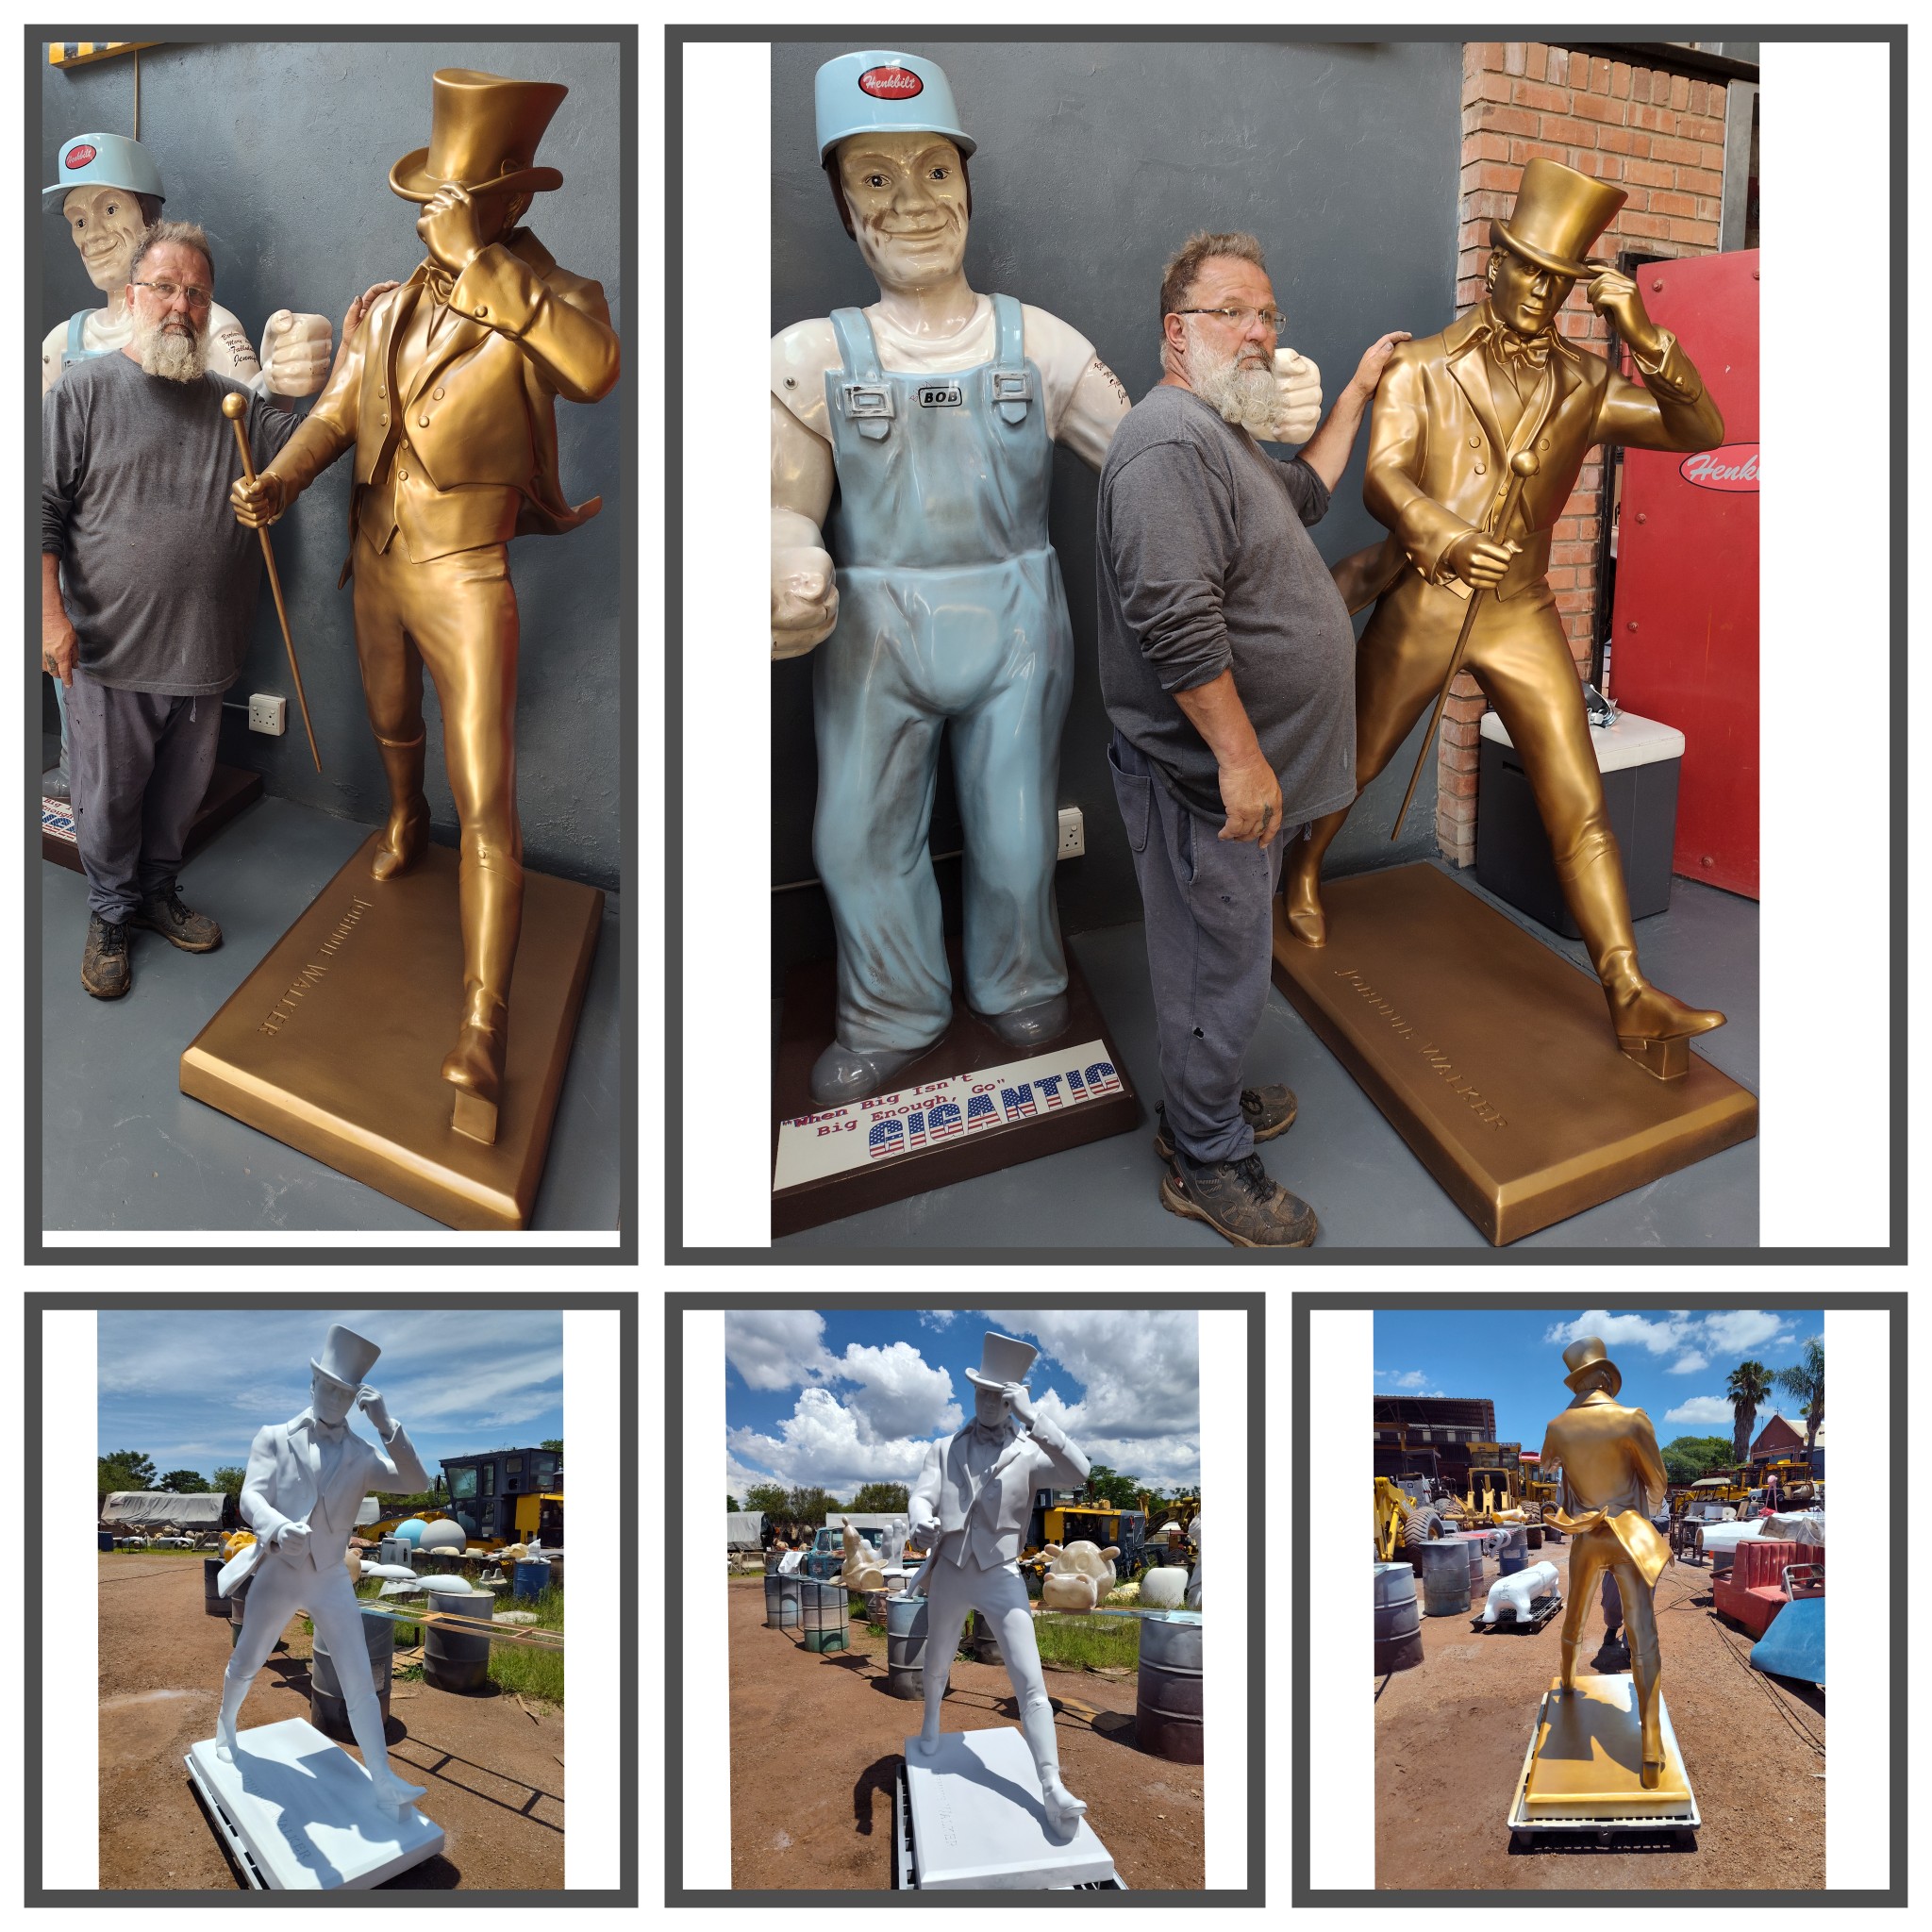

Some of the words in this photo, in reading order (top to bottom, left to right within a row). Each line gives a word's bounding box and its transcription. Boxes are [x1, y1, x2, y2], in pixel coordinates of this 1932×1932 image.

[862, 75, 916, 90] Henkbilt
[924, 391, 958, 404] BOB
[316, 895, 375, 958] JOHNNIE
[257, 963, 328, 1036] WALKER
[1334, 968, 1420, 1040] JOHNNIE
[1419, 1041, 1508, 1131] WALKER
[817, 1120, 858, 1137] Big
[870, 1095, 957, 1122] Enough,
[972, 1078, 1005, 1094] Go"
[860, 1094, 900, 1110] Big
[913, 1074, 973, 1095] Isn't
[869, 1062, 1121, 1159] GIGANTIC
